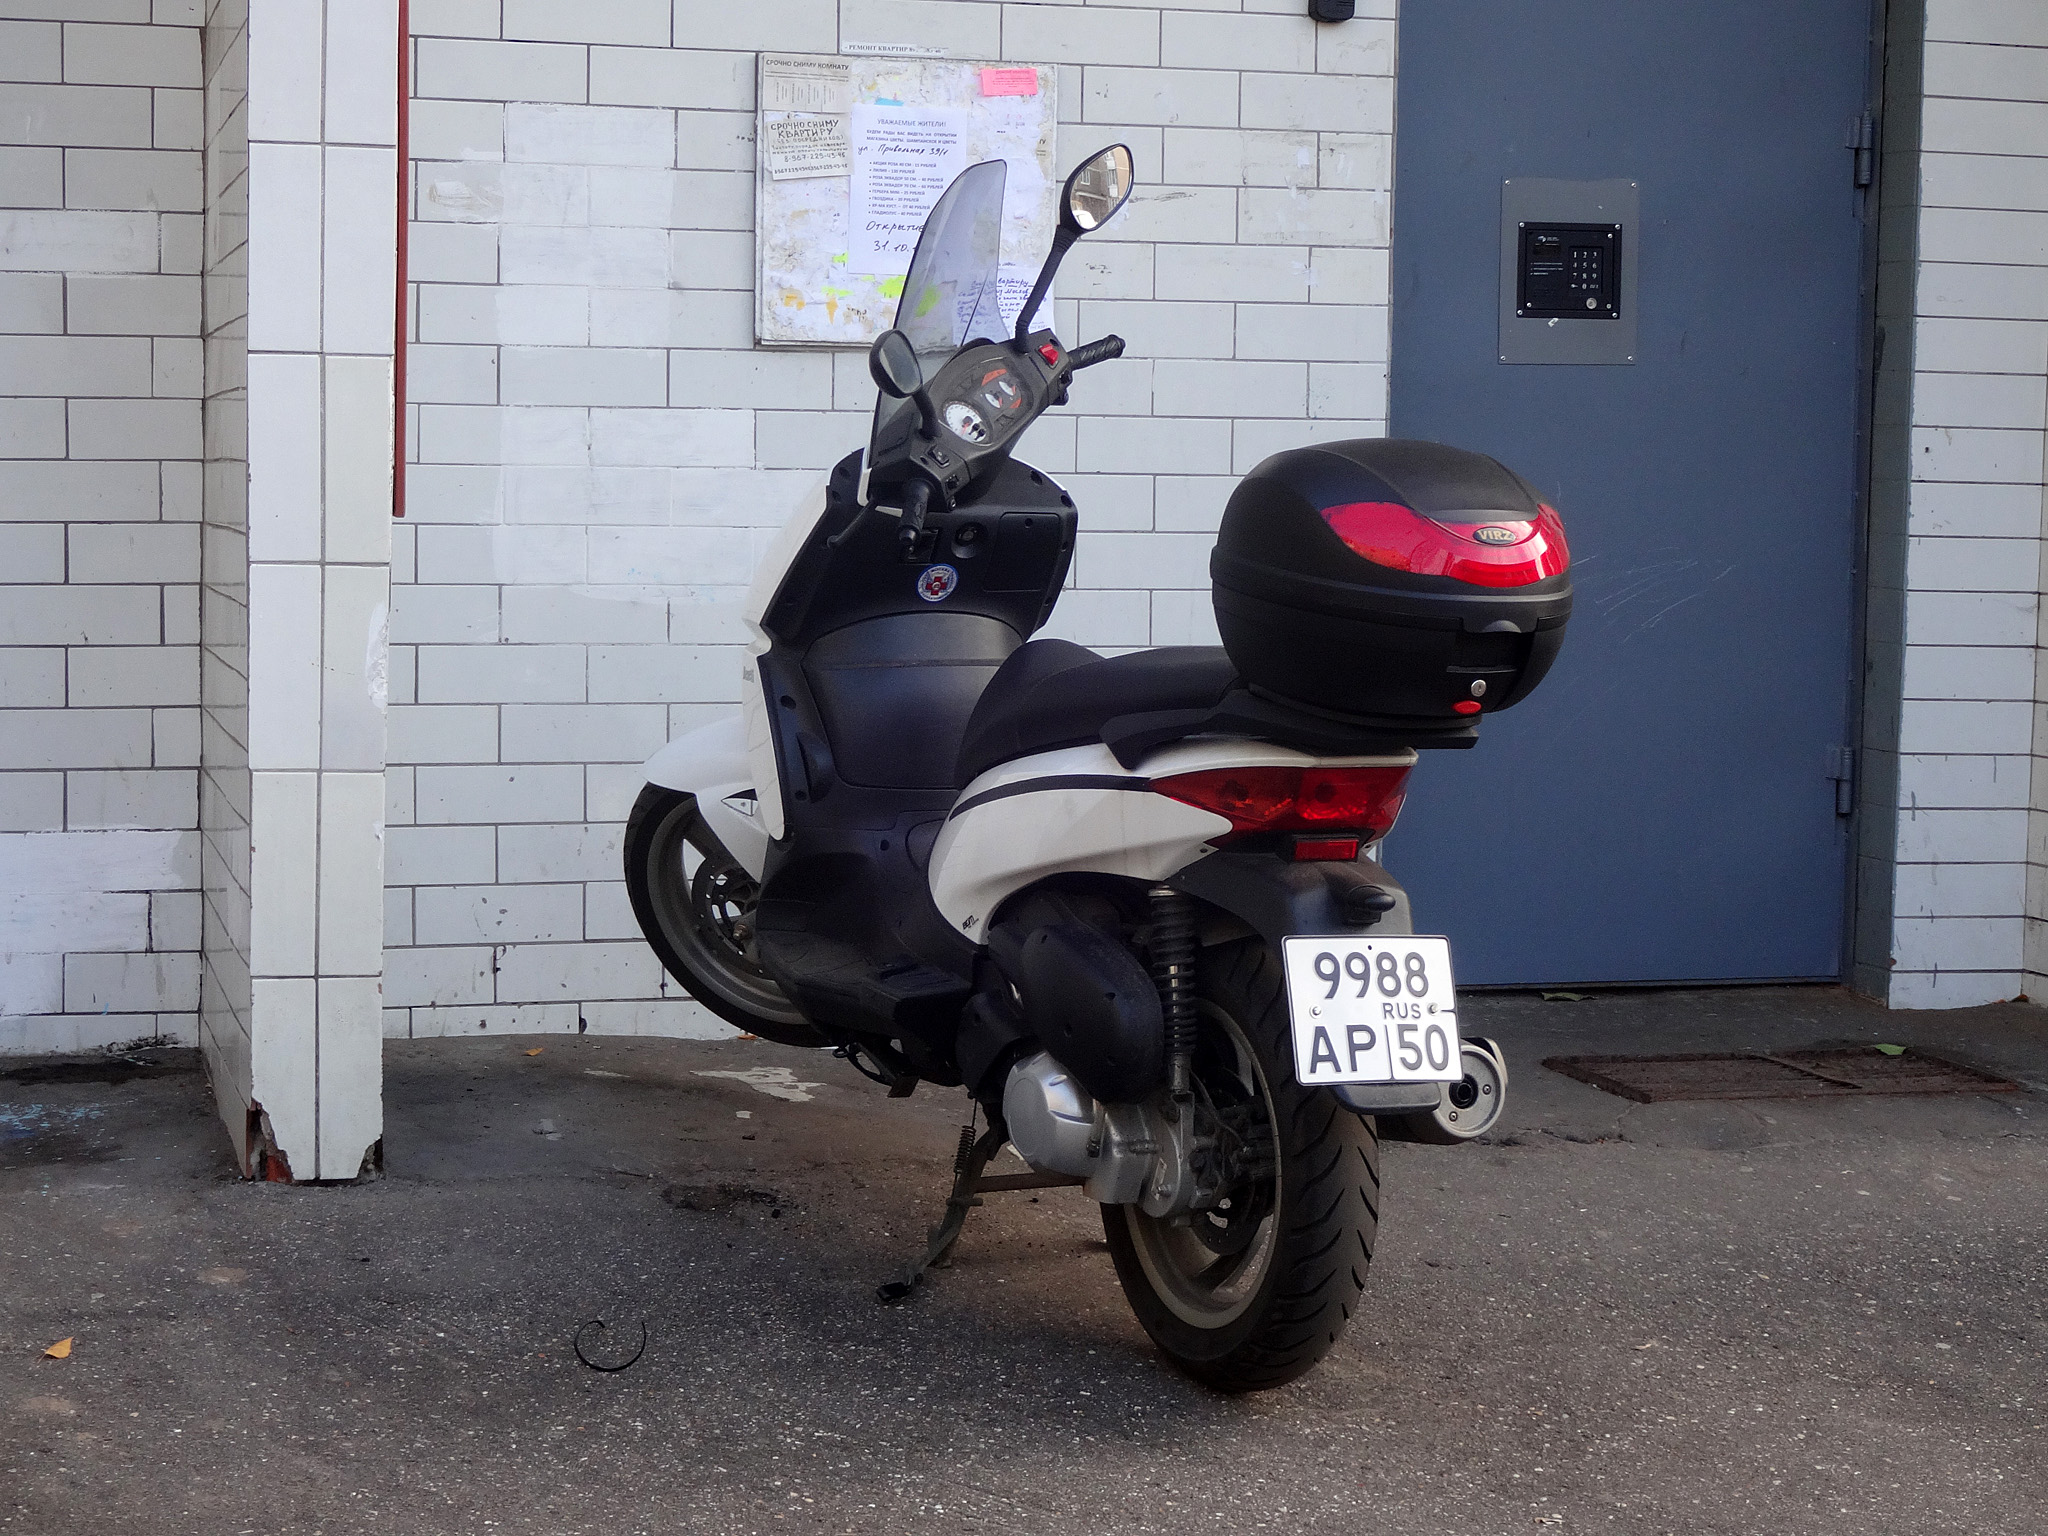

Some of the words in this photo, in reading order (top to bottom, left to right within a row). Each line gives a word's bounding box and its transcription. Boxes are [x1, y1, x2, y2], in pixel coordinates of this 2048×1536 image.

[766, 59, 792, 67] СРОЧНО
[818, 63, 850, 71] КОМНАТУ
[770, 122, 804, 130] СРОЧНО
[807, 120, 839, 128] СНИМУ
[778, 128, 834, 138] КВАРТИРУ
[878, 144, 925, 155] Привольная
[866, 220, 926, 235] Открытие
[1314, 951, 1429, 999] 9988
[1382, 1002, 1422, 1020] RUS
[1397, 1023, 1450, 1071] 50
